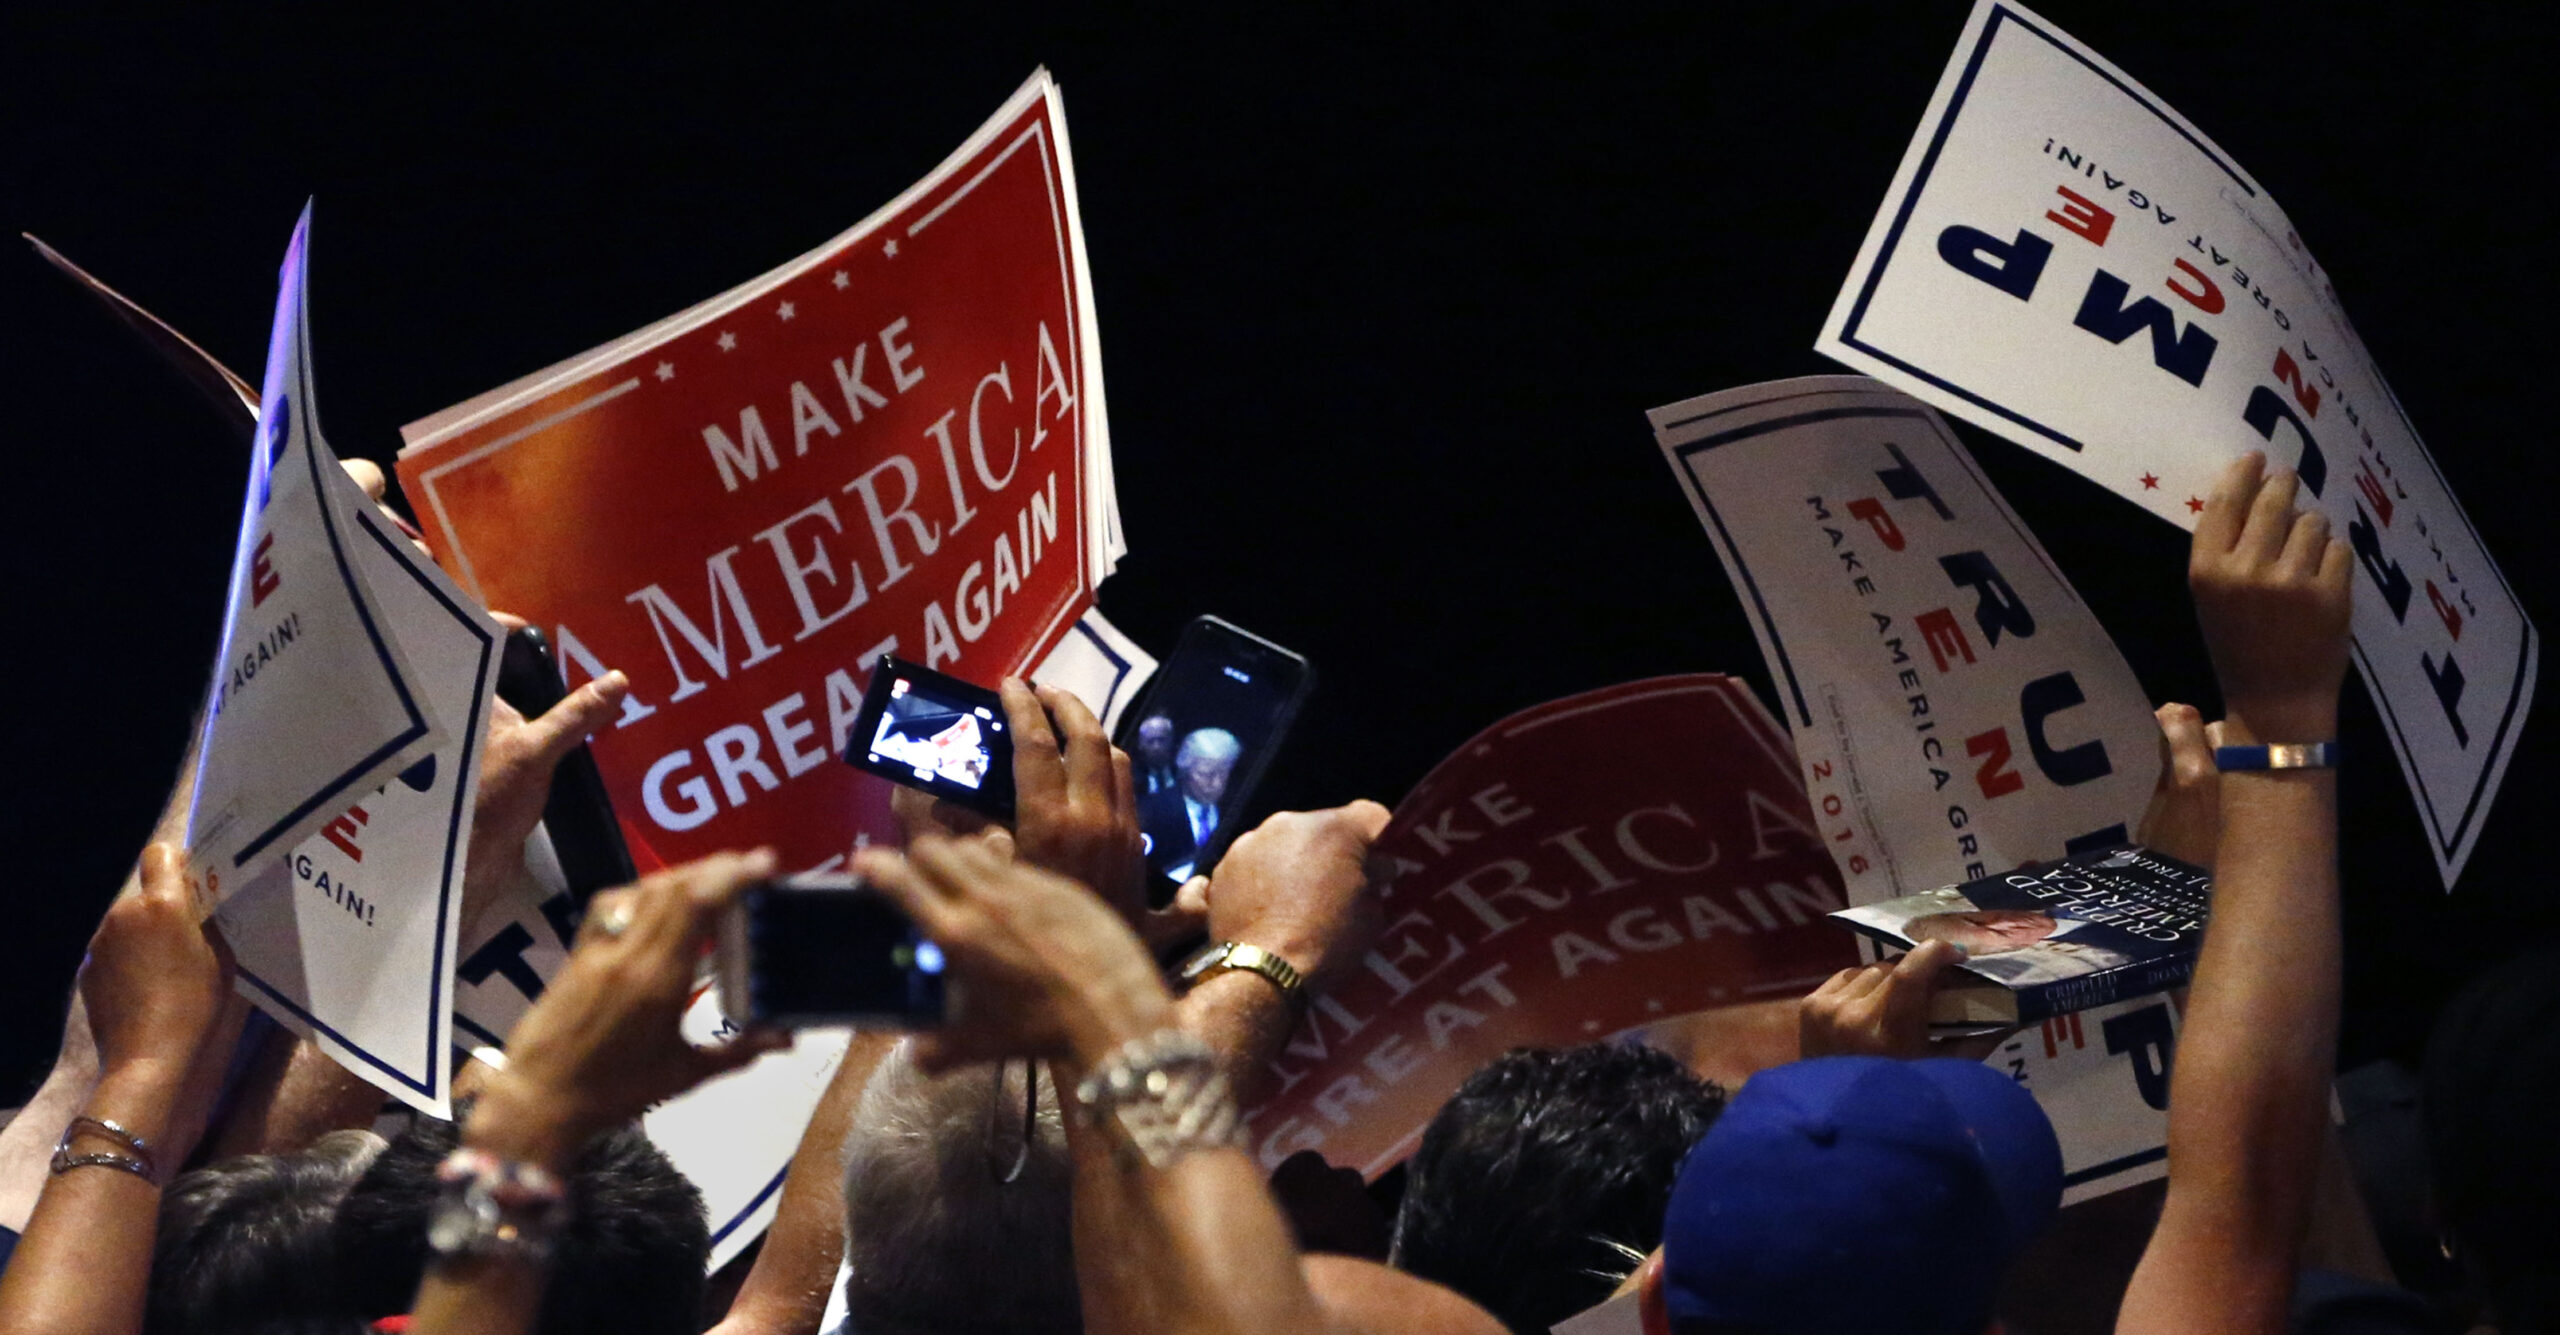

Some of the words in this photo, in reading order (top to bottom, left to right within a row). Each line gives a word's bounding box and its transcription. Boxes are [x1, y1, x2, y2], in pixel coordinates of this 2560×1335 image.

[2043, 138, 2177, 226] AGAIN!
[2188, 235, 2292, 332] GREAT
[701, 316, 926, 493] MAKE
[1936, 224, 2470, 751] TRUMP
[2045, 184, 2464, 642] PENCE
[554, 320, 1077, 742] AMERICA
[922, 472, 1059, 671] AGAIN
[234, 612, 303, 694] AGAIN!
[1805, 495, 1877, 597] MAKE
[1870, 610, 1953, 792] AMERICA
[1846, 496, 2038, 870] PEN
[1875, 442, 2131, 856] TRU
[1380, 782, 1536, 897] KE
[1811, 758, 1871, 876] 2016
[2005, 874, 2180, 942] CRIPPLED
[2042, 868, 2200, 931] AMERICA
[1243, 787, 1826, 1122] MERICA
[1257, 962, 1518, 1176] GREAT
[1549, 873, 1848, 980] AGAIN
